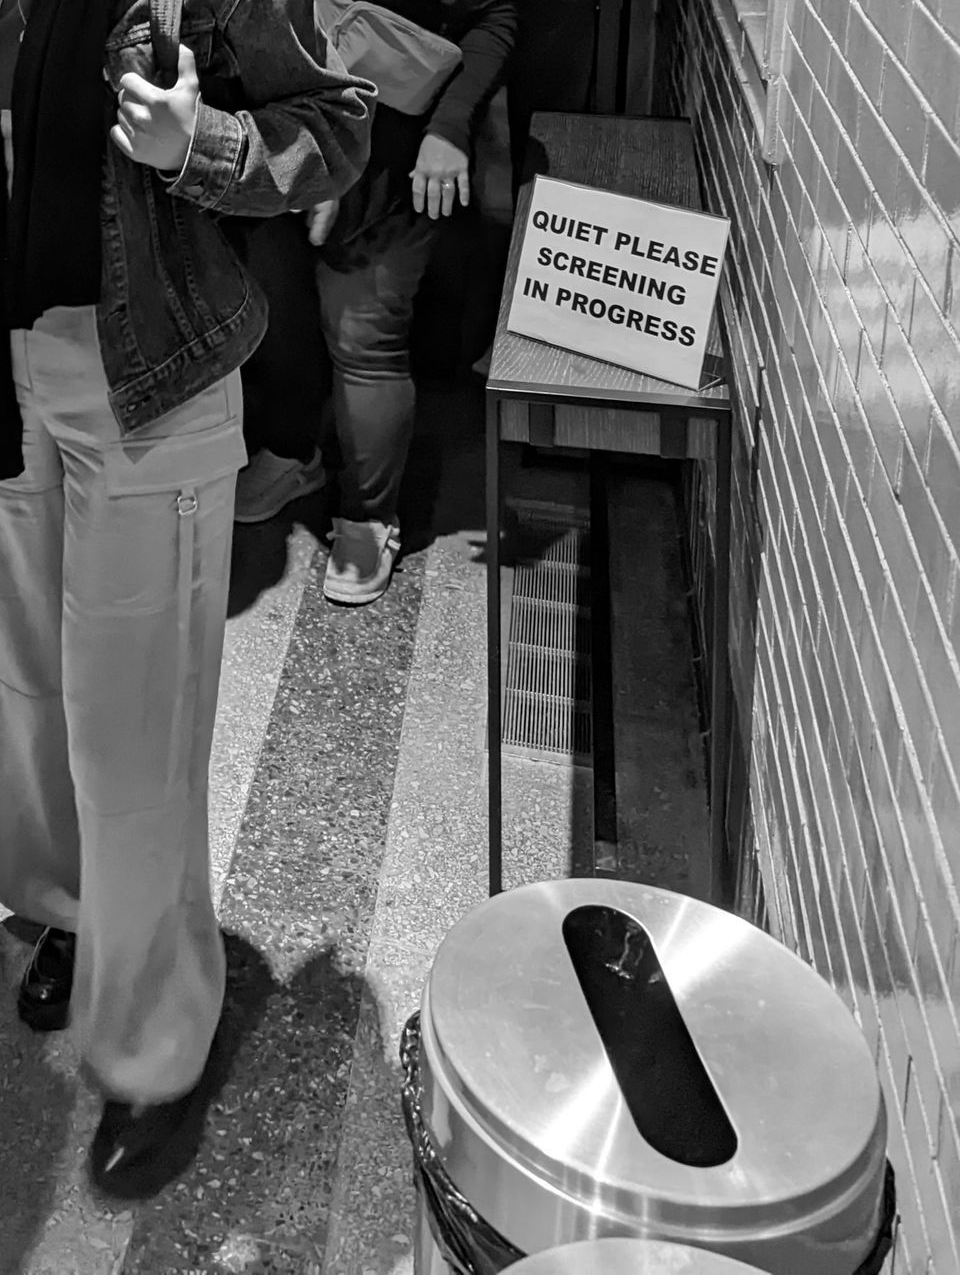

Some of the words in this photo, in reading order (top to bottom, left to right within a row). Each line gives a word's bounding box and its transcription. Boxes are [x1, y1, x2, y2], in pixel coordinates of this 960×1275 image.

[532, 210, 608, 245] QUIET
[614, 231, 719, 277] PLEASE
[537, 247, 686, 305] SCREENING
[523, 277, 549, 301] IN
[555, 287, 696, 346] PROGRESS
